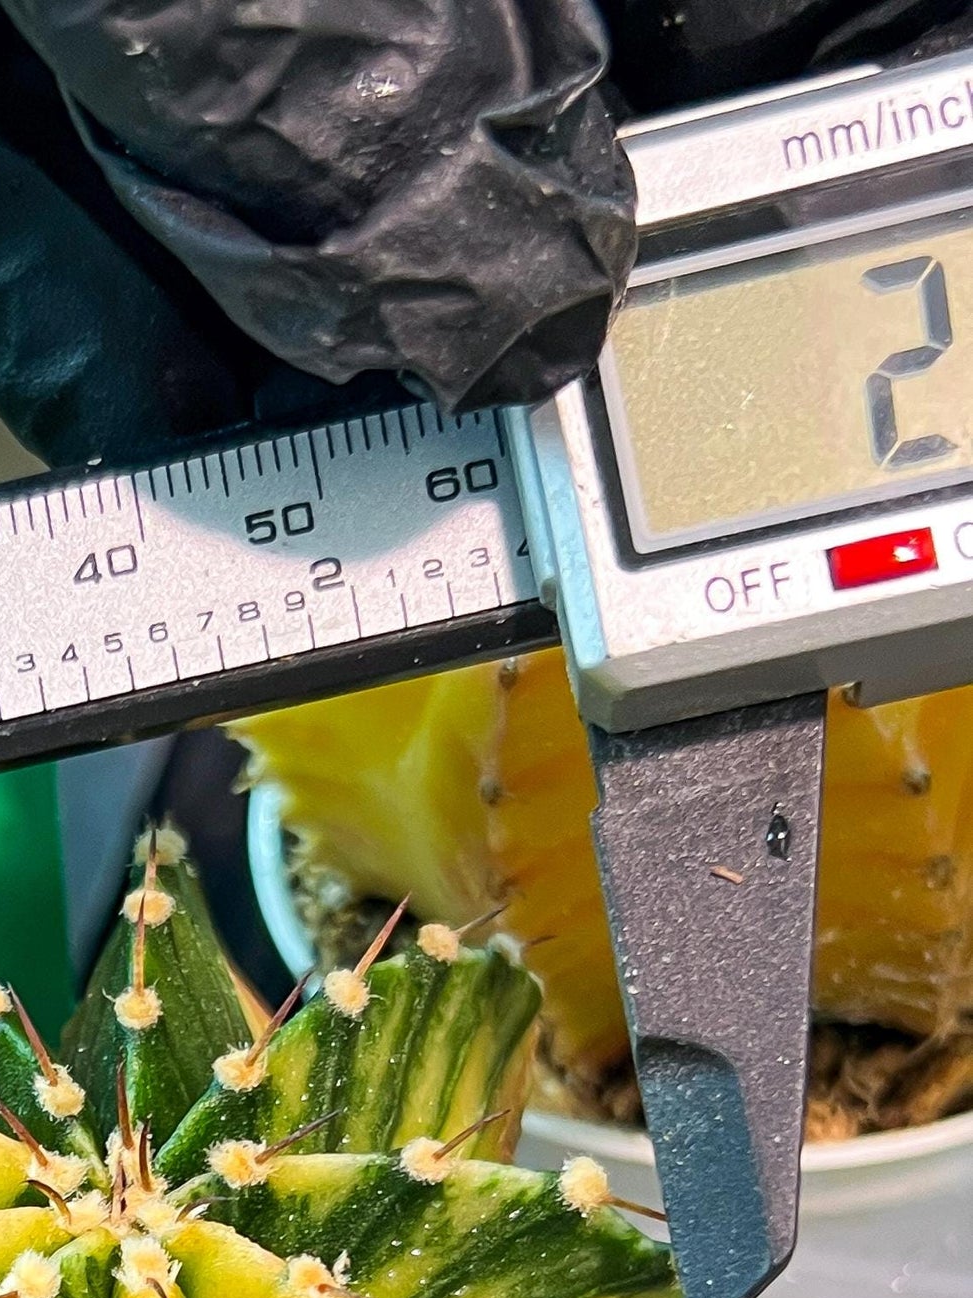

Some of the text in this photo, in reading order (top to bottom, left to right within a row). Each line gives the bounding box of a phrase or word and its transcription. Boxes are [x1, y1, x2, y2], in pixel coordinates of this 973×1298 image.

[860, 256, 958, 463] 2
[73, 543, 138, 584] 40
[244, 501, 315, 545] 50
[425, 457, 499, 503] 60
[16, 653, 36, 673] 3
[61, 643, 79, 662] 4
[103, 632, 124, 654] 5
[148, 621, 169, 643] 6
[196, 610, 214, 632] 7
[237, 600, 261, 622] 8
[284, 590, 306, 613] 9
[309, 556, 345, 591] 2
[386, 568, 396, 588] 1
[422, 558, 445, 579] 2
[468, 547, 491, 568] 3
[704, 562, 790, 613] OFF
